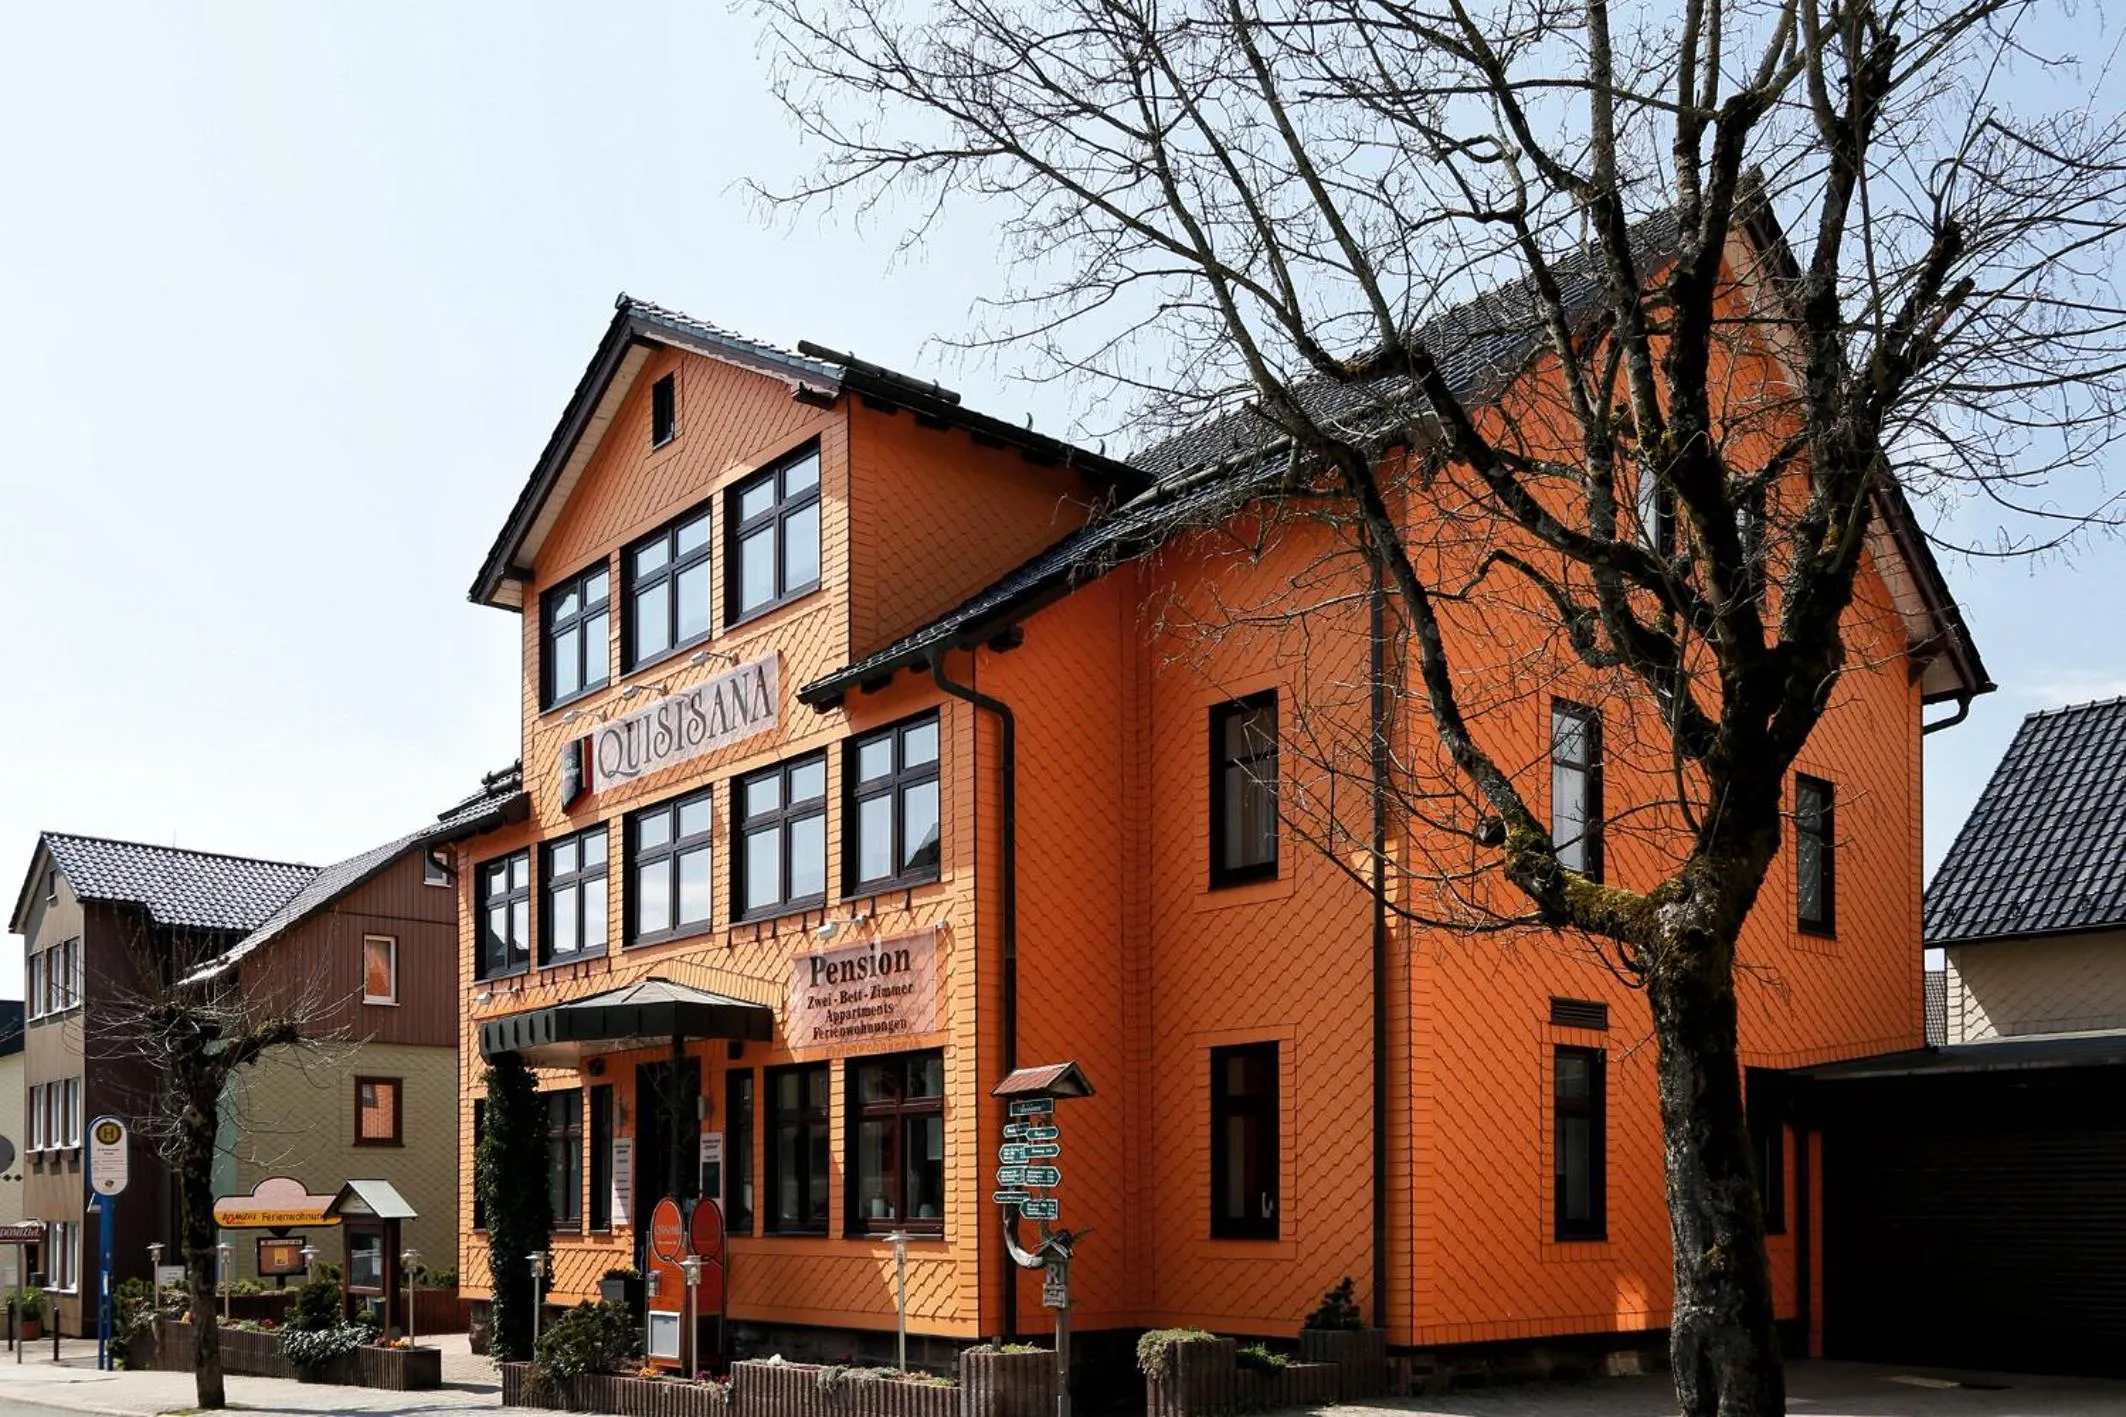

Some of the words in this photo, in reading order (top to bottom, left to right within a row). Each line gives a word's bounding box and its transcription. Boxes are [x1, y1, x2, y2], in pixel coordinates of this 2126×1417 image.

[599, 665, 773, 779] QUISISANA
[809, 942, 911, 988] Pension
[825, 1002, 894, 1026] Appartments
[813, 1018, 907, 1040] Ferienwohnungen
[103, 1127, 115, 1139] H
